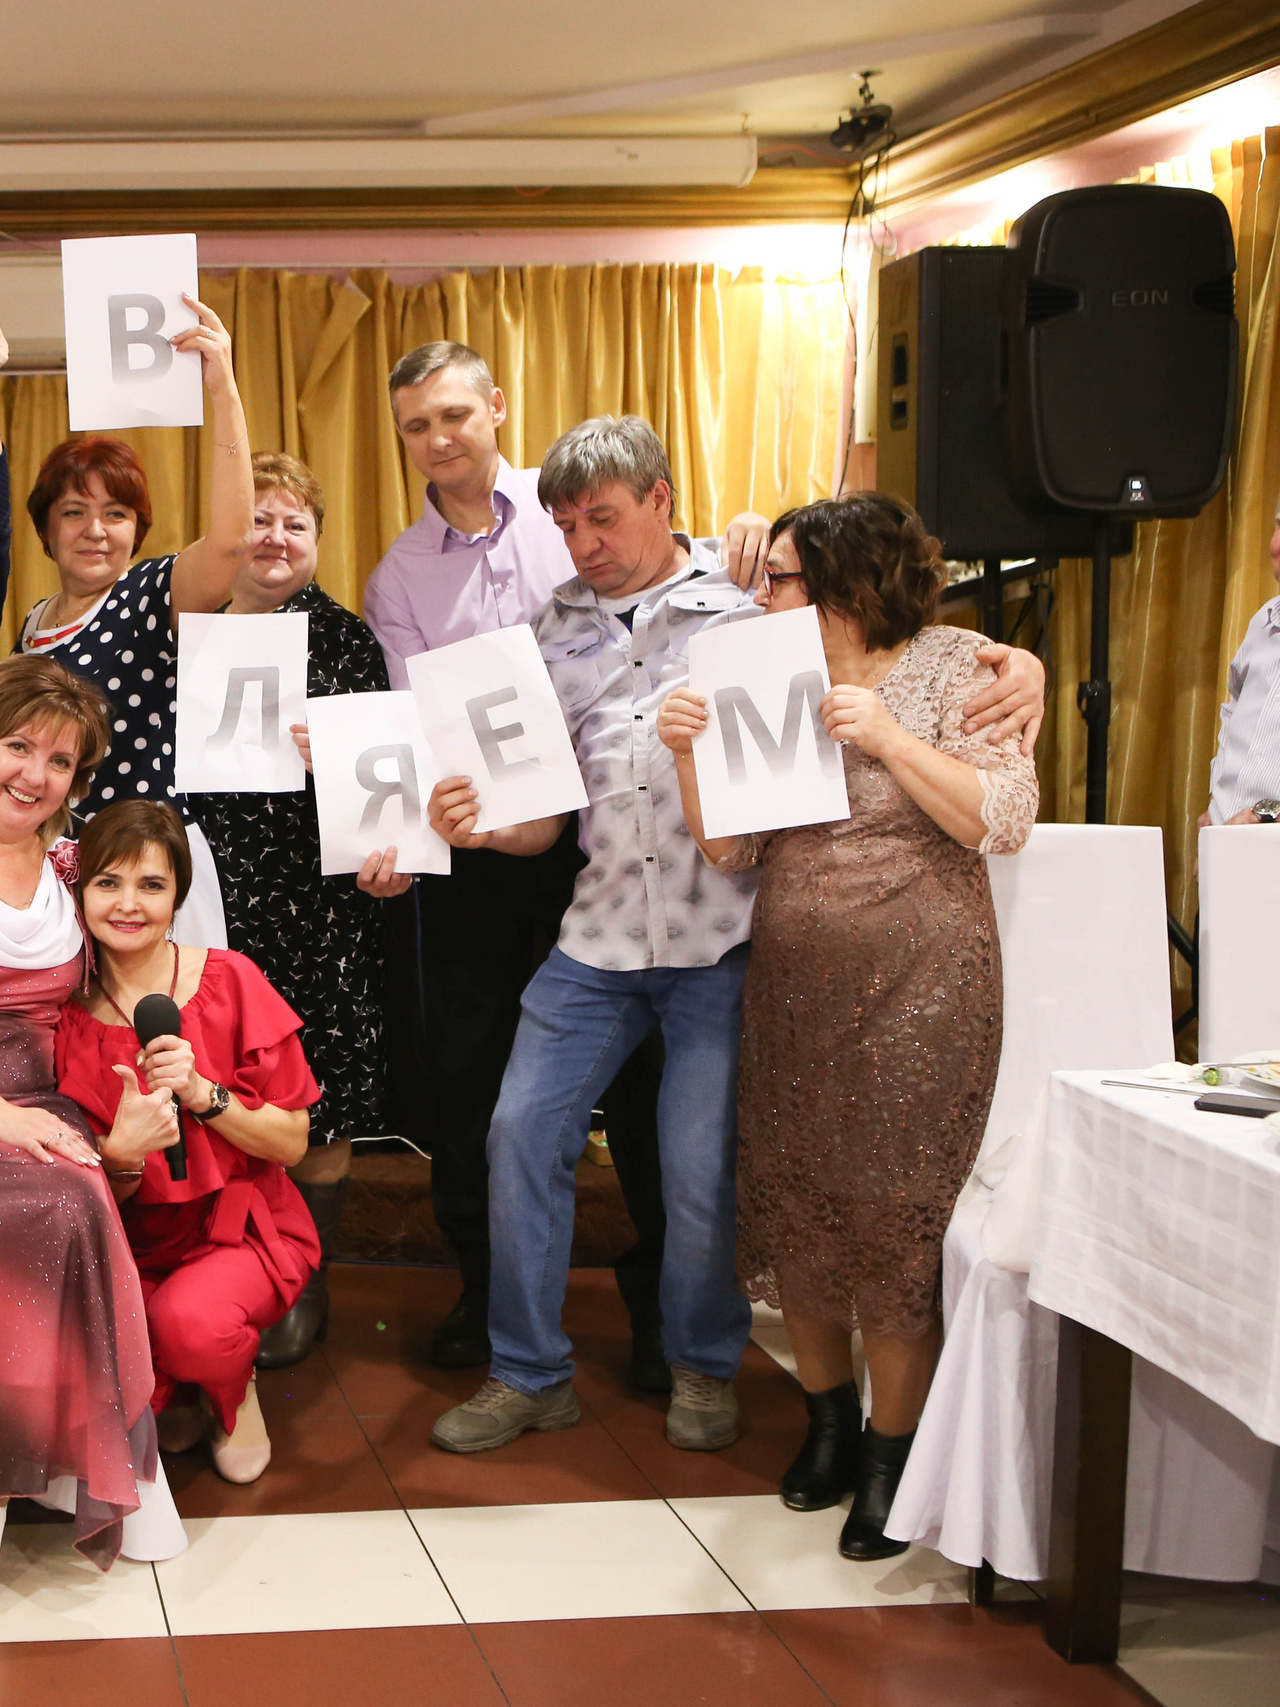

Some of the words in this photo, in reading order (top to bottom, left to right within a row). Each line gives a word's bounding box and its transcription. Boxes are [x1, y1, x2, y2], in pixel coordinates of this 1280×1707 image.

[107, 293, 173, 385] В
[1111, 289, 1168, 307] EON
[205, 666, 280, 751] Л
[465, 685, 541, 782] Е
[714, 670, 841, 785] М
[355, 743, 422, 834] Я
